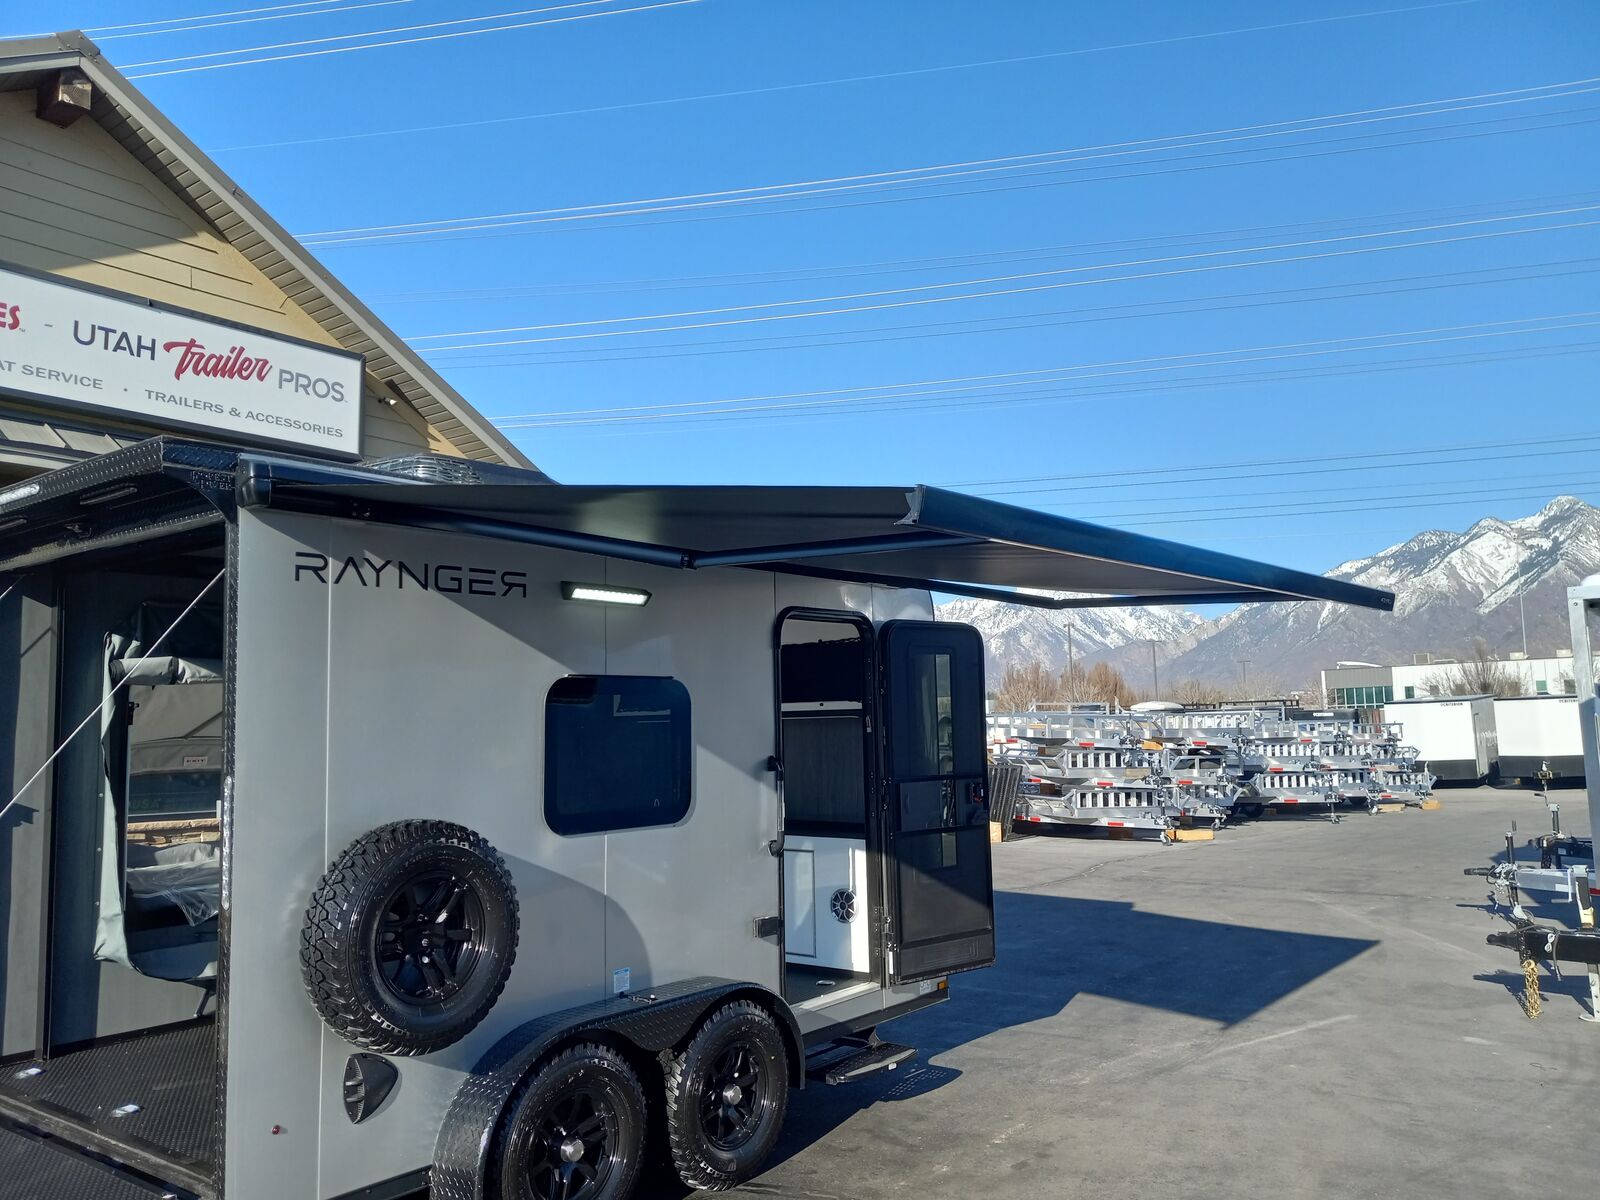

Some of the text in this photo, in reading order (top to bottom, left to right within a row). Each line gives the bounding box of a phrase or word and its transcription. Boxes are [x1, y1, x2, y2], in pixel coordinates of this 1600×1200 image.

[73, 320, 156, 361] UTAH
[163, 337, 273, 382] Trailer
[277, 367, 345, 402] PROS
[21, 364, 103, 390] SERVICE
[144, 389, 224, 414] TRAILERS
[228, 407, 241, 418] &
[245, 411, 343, 438] ACCESSORIES
